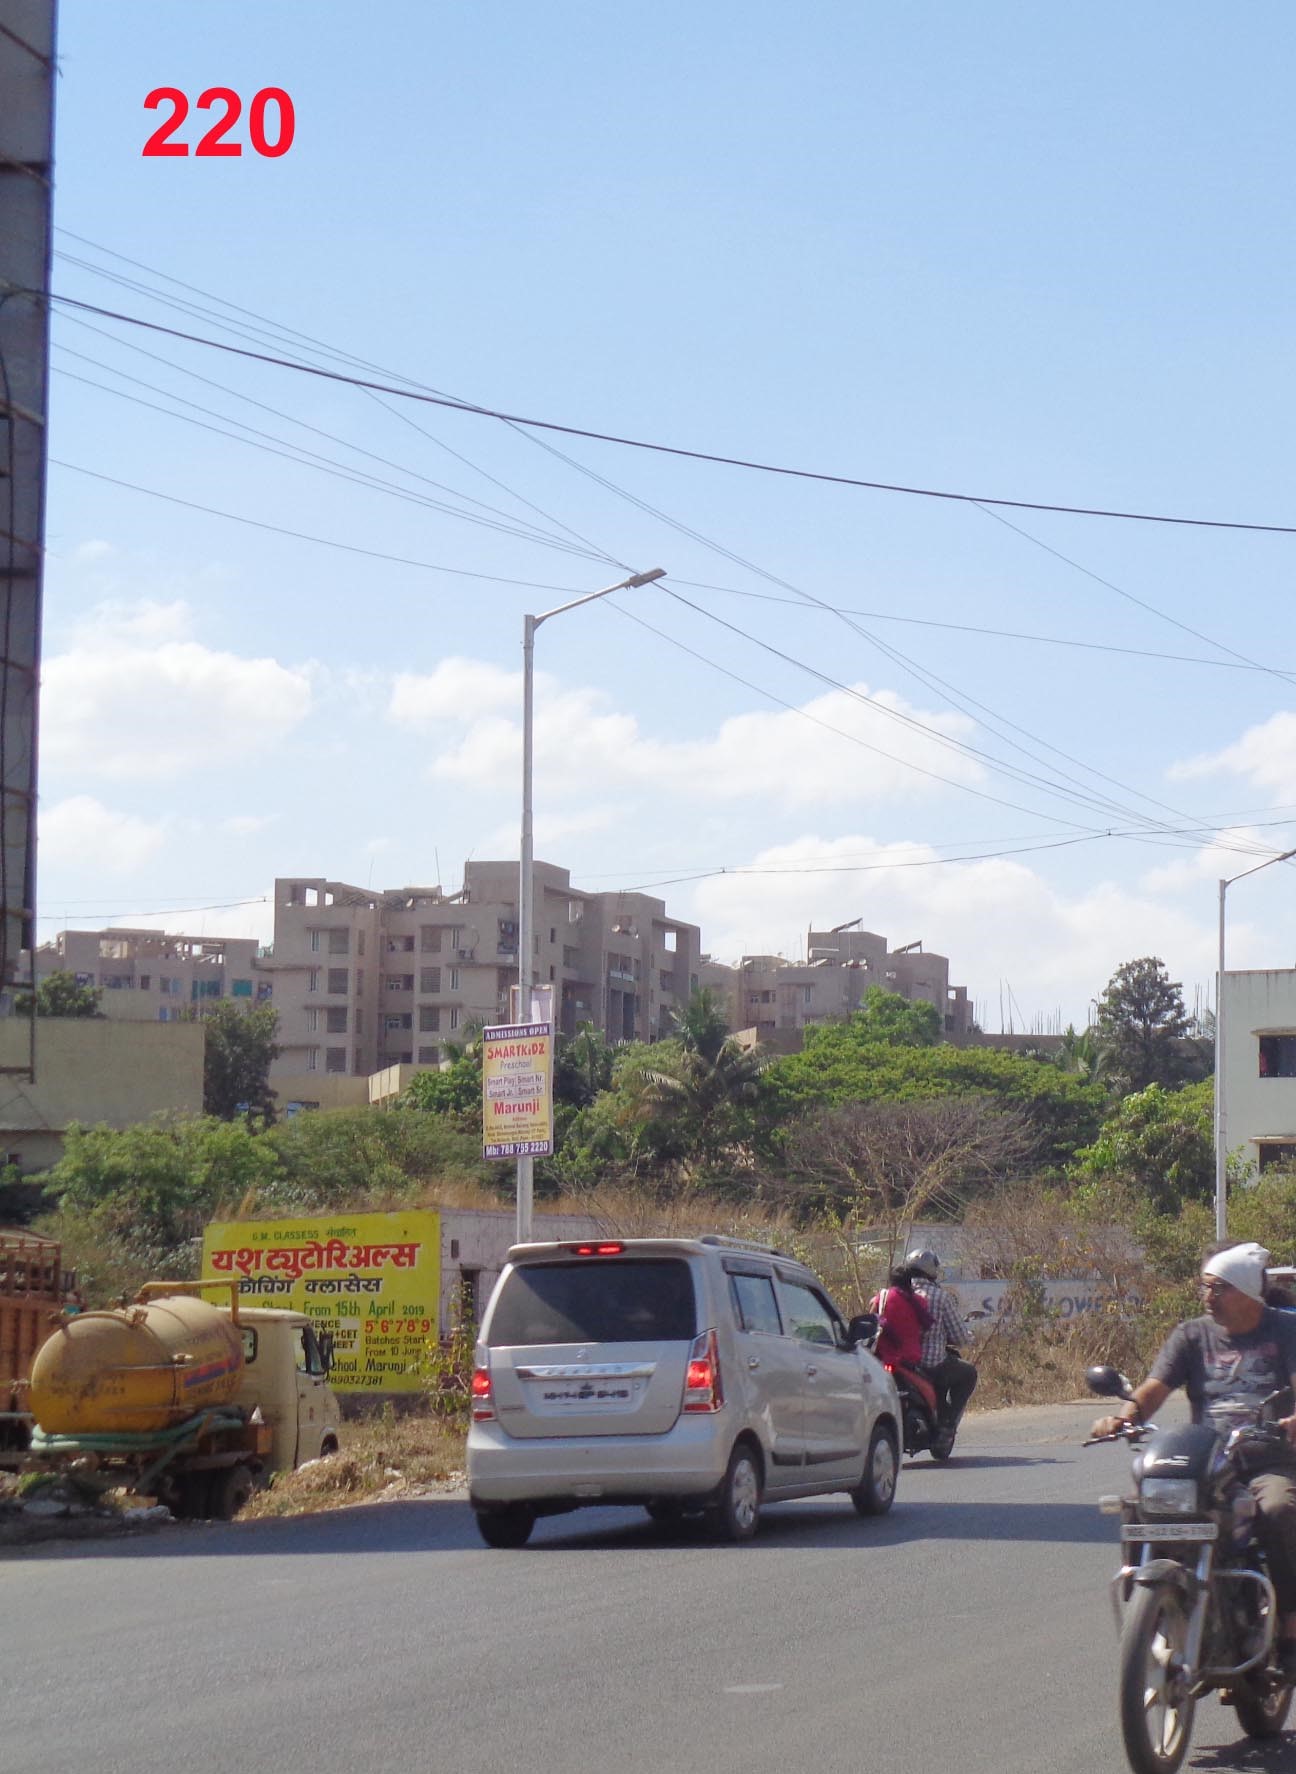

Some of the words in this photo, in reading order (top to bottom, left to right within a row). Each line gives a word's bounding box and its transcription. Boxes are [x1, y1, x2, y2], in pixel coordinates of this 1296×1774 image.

[485, 1029, 528, 1040] ADMISSIONS
[529, 1025, 548, 1035] OPEN
[494, 1099, 540, 1115] Marunji
[305, 1273, 383, 1294] क्लासेस
[335, 1301, 360, 1317] 15th
[369, 1301, 395, 1320] April
[403, 1305, 425, 1316] 2019
[366, 1358, 406, 1375] Marunji
